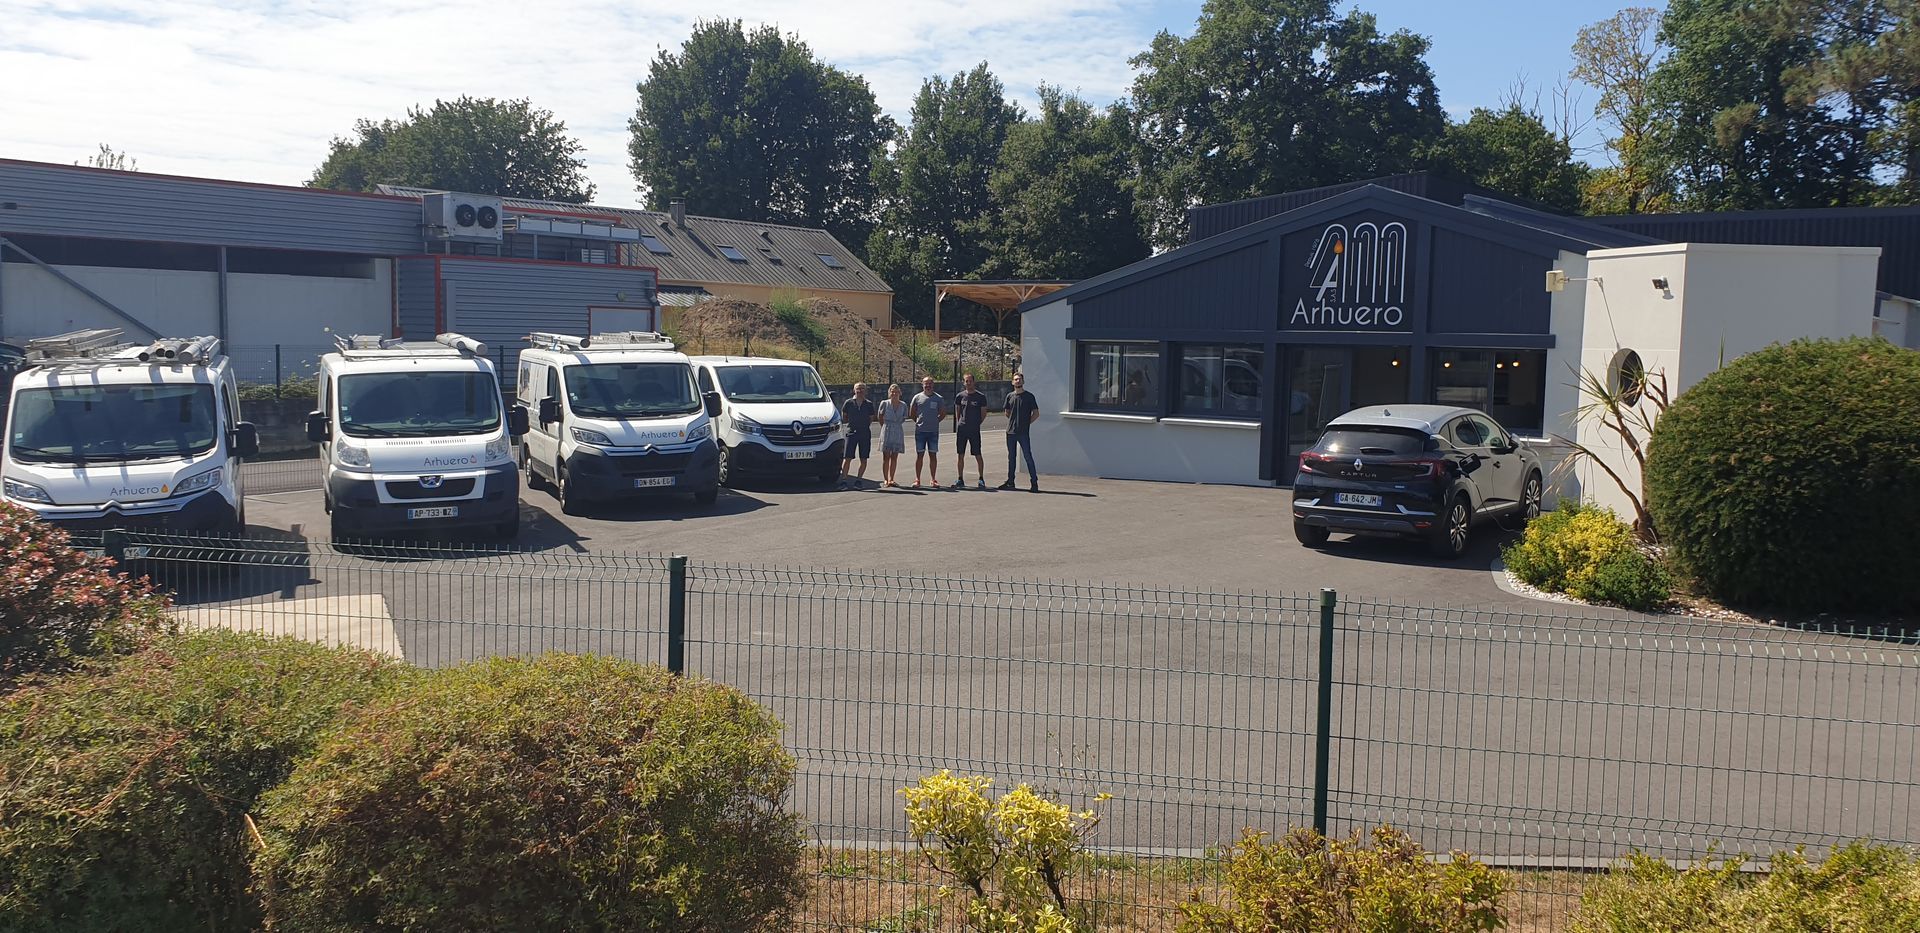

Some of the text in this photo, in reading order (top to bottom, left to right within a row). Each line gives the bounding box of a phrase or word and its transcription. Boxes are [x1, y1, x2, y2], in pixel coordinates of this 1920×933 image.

[1290, 297, 1403, 325] Arhuero
[641, 431, 678, 439] Arhuero
[424, 457, 469, 467] Arhuero
[1340, 470, 1377, 478] CAPTUR
[109, 486, 160, 497] Arhuero
